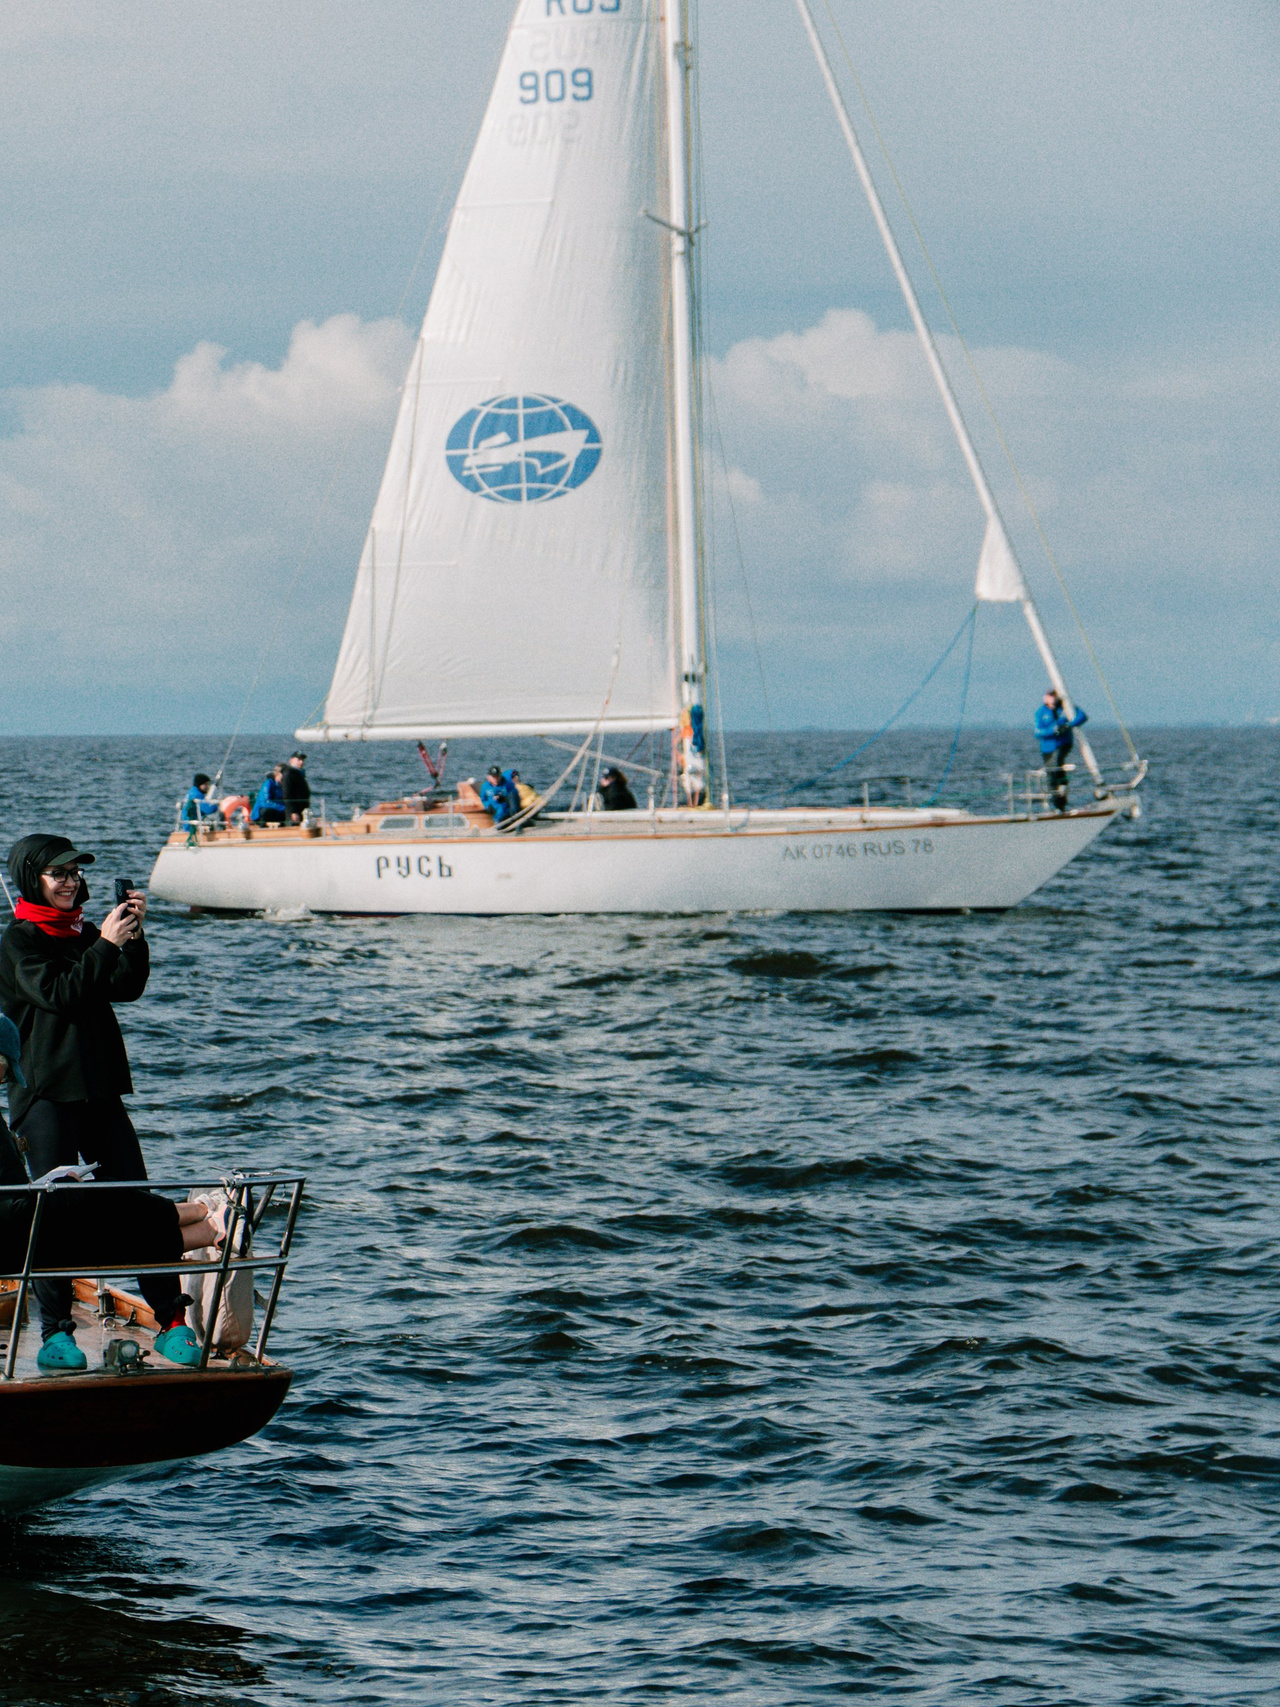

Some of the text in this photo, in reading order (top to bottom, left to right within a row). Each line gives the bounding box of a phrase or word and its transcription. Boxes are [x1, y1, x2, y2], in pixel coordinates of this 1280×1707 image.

[519, 68, 593, 104] 909
[812, 844, 857, 859] 0746
[863, 840, 906, 856] RUS
[911, 839, 934, 854] 78
[376, 855, 453, 878] РУСЬ
